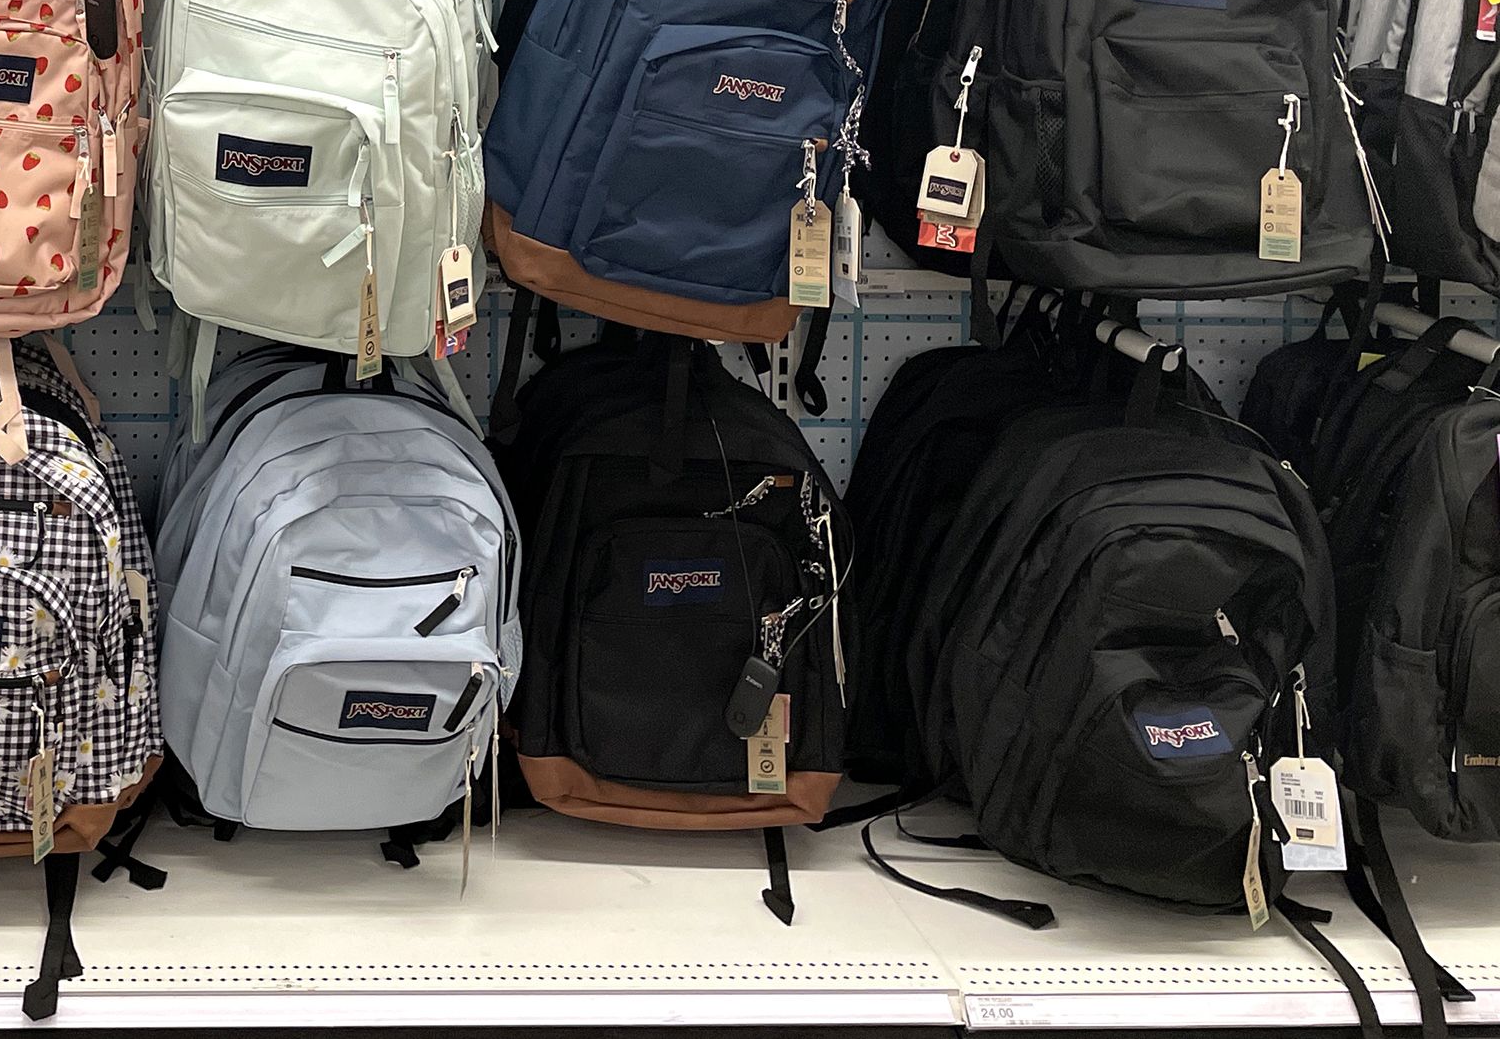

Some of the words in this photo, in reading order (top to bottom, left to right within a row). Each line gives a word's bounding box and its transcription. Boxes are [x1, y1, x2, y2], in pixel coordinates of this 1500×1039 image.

[713, 74, 786, 102] JANSPORT
[220, 149, 305, 176] JANSPORT
[647, 570, 721, 595] JANSPORT
[347, 703, 429, 722] JANSPORT
[1144, 721, 1220, 749] JANSPORT
[1464, 753, 1500, 767] Embar
[981, 1007, 1014, 1019] 24.00
